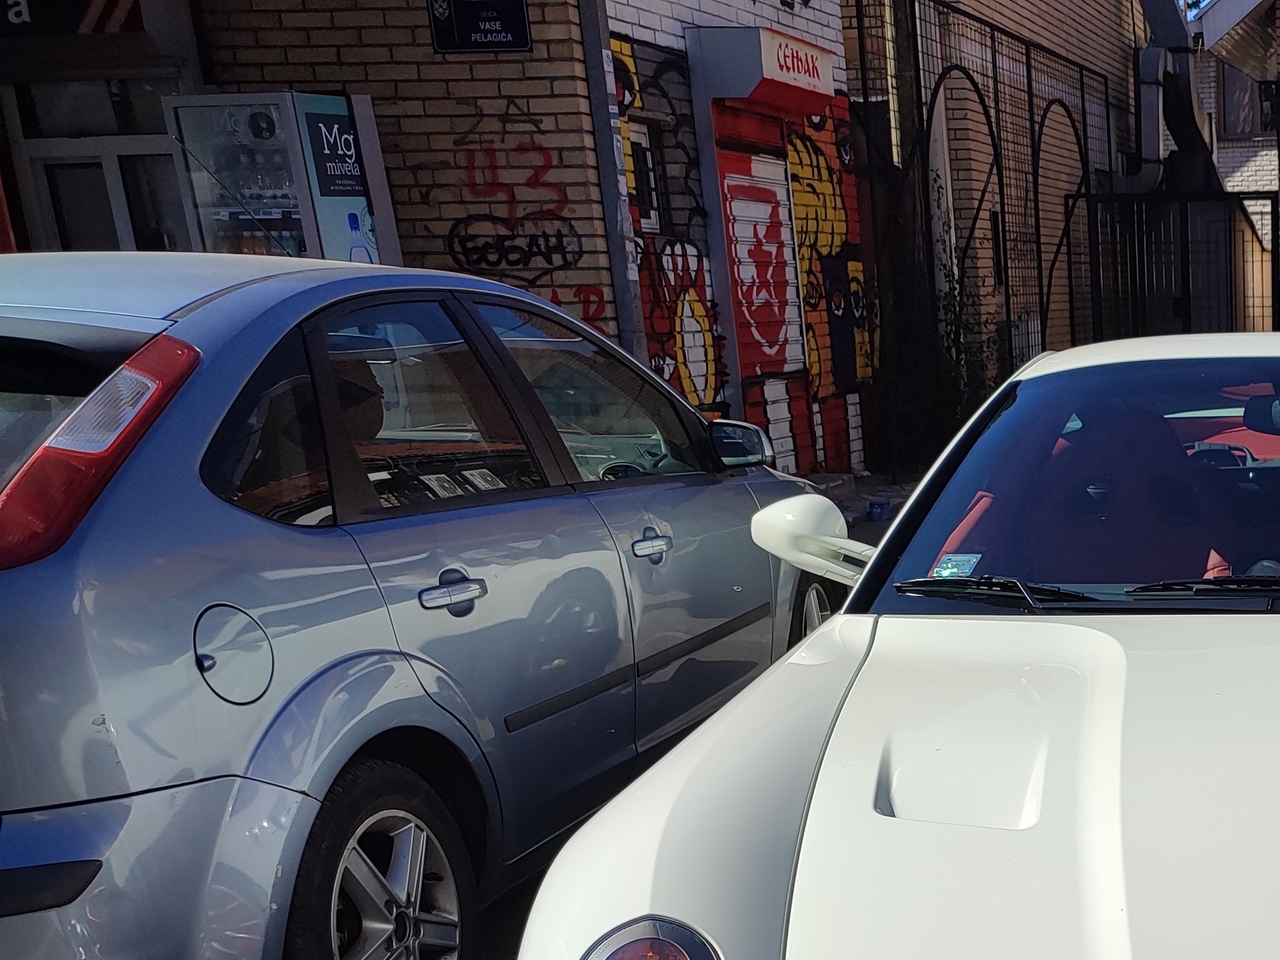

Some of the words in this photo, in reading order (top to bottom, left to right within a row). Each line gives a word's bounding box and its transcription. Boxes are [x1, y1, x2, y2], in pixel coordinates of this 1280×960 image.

[479, 21, 502, 30] VASE
[471, 31, 513, 42] PELAGIĆA
[777, 42, 821, 81] СЕЊАК
[326, 159, 361, 176] mivela
